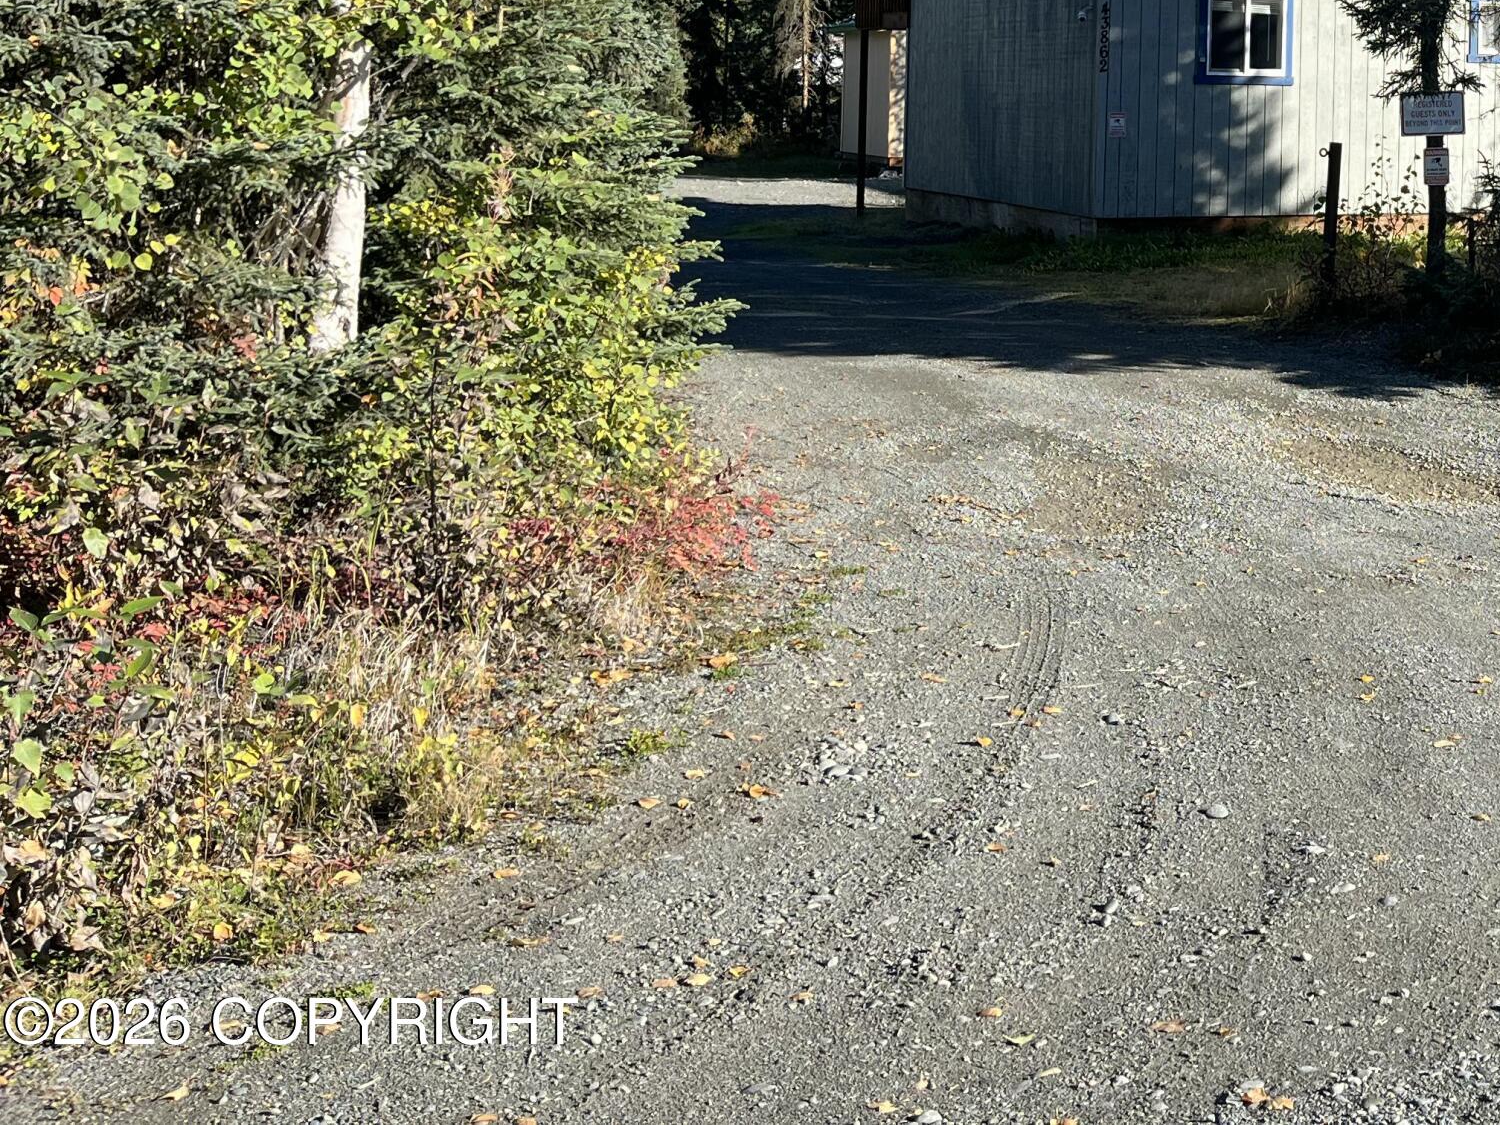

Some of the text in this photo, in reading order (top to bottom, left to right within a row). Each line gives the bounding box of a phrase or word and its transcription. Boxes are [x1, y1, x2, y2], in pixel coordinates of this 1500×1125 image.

[1100, 1, 1110, 73] 43862
[1414, 100, 1453, 108] REGISTERED
[1410, 109, 1455, 118] GUESTS ONLY
